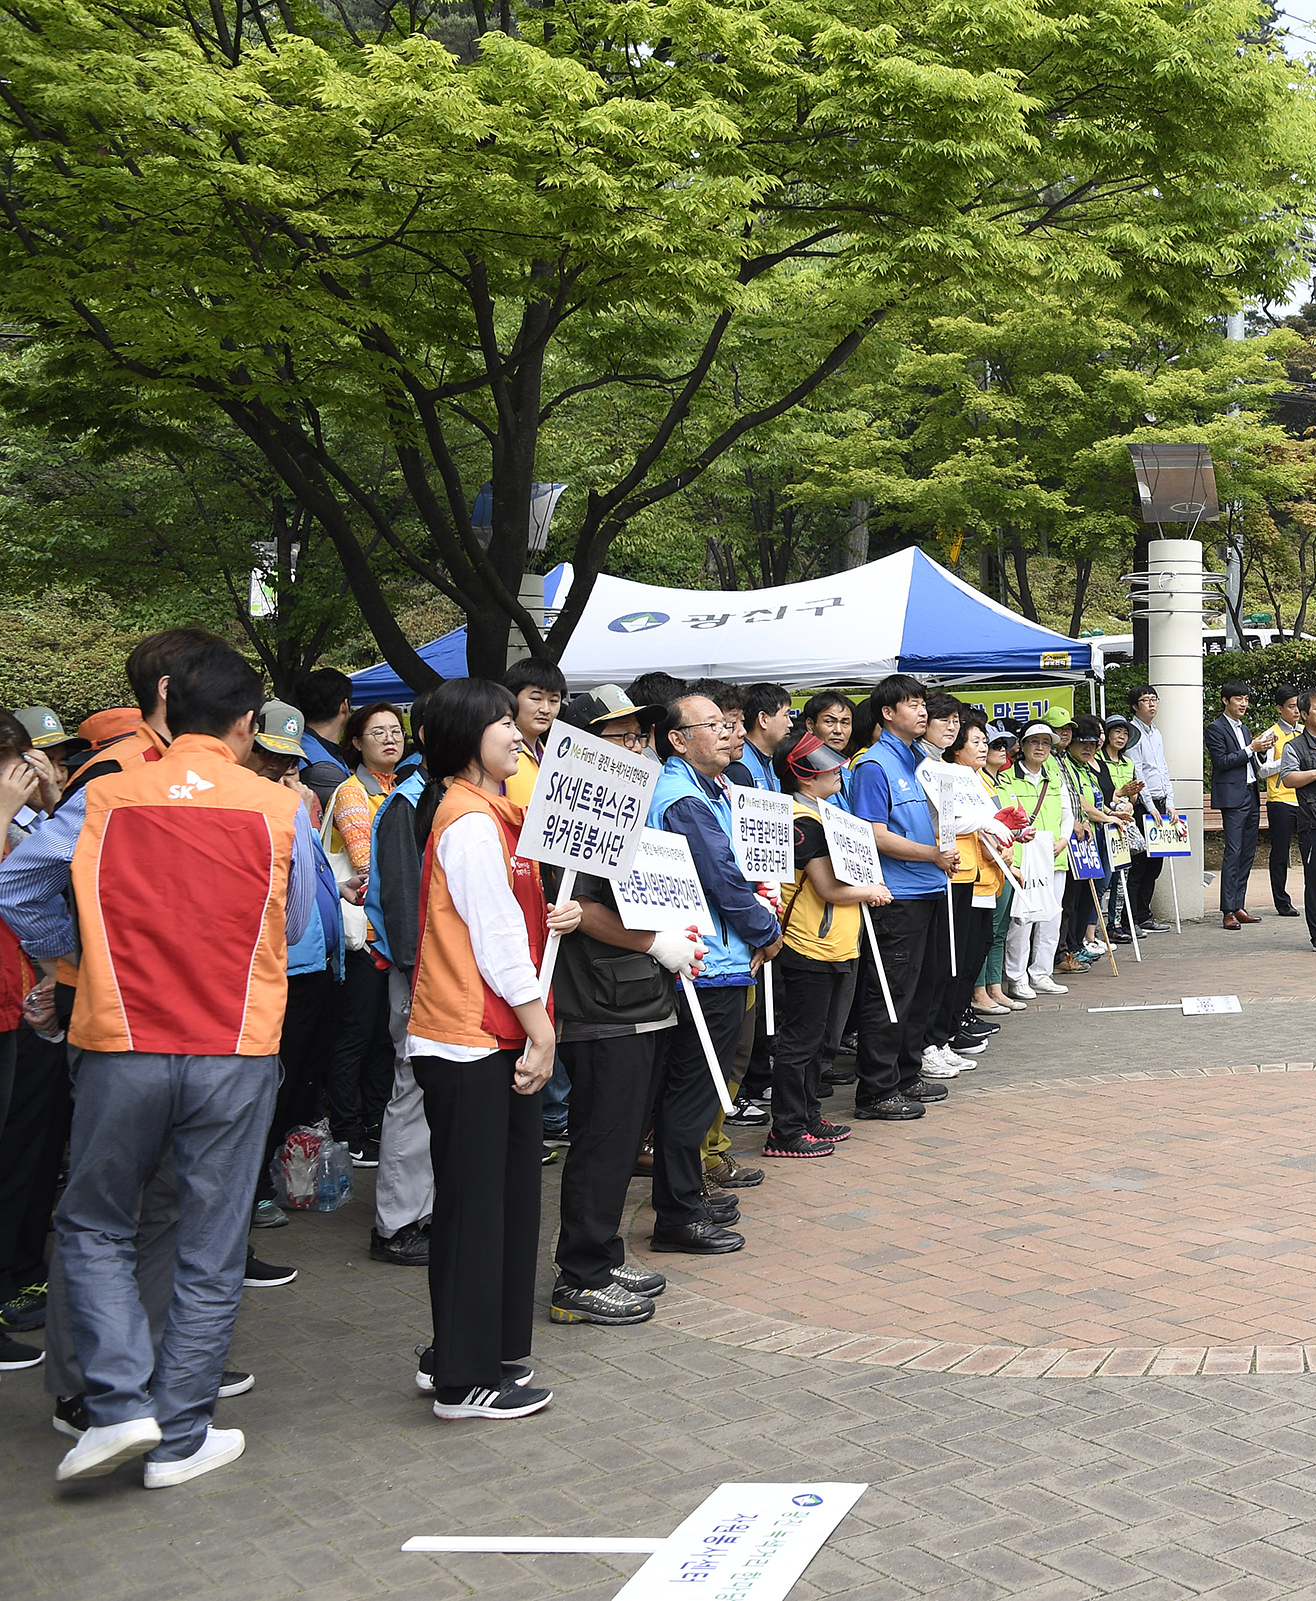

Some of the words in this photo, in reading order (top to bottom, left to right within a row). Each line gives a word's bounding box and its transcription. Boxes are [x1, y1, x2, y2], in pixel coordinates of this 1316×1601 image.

[681, 596, 846, 630] 광진구
[570, 743, 581, 759] Me
[580, 747, 597, 766] First!
[597, 753, 611, 773] 광진
[168, 785, 195, 800] SK
[545, 771, 641, 832] SK네트웍스(주)
[543, 814, 625, 867] 워커힐봉사단
[739, 816, 790, 847] 한국열관리협회
[745, 846, 788, 874] 성동광진구회
[668, 1512, 759, 1583] 자원봉사센터
